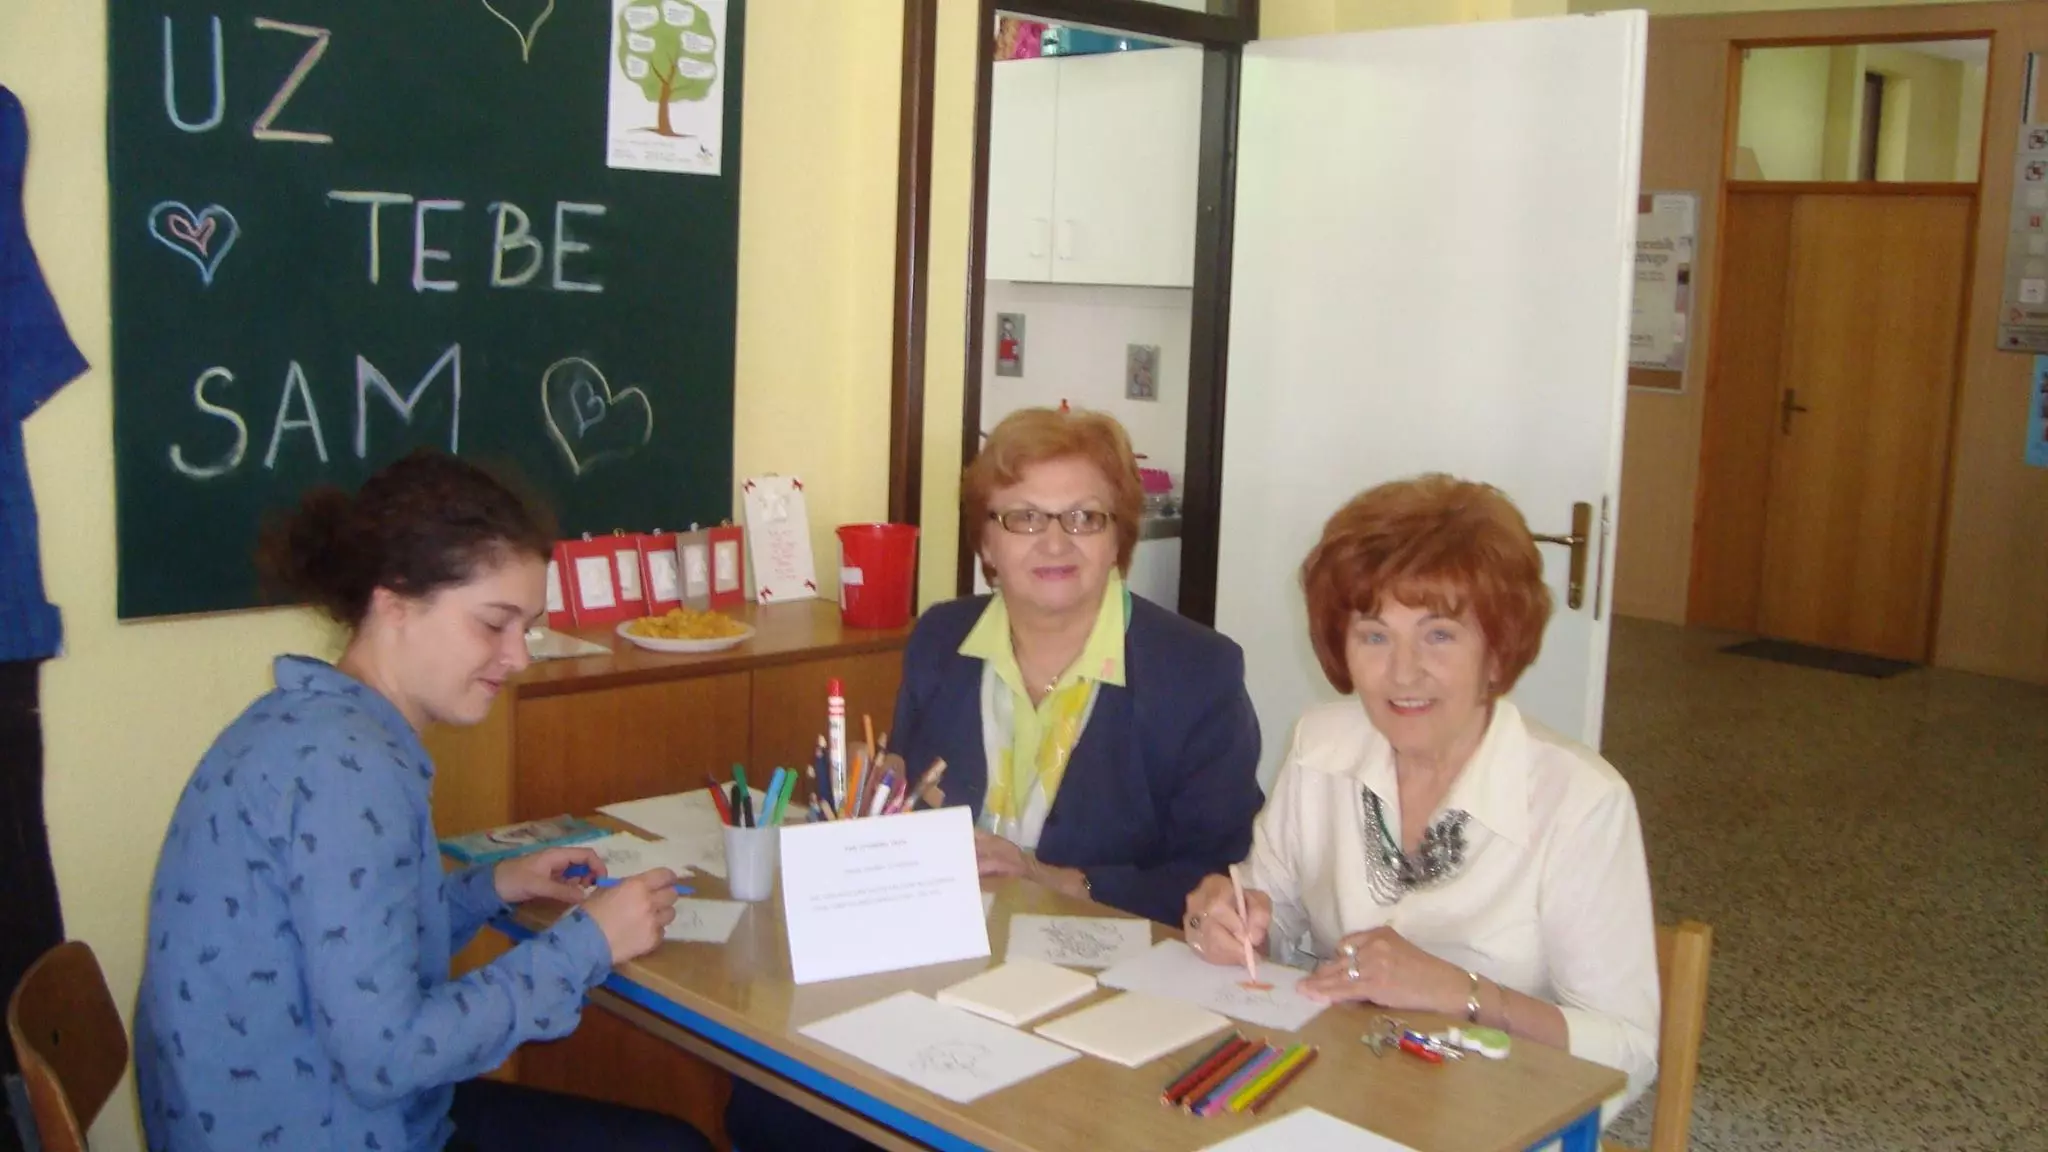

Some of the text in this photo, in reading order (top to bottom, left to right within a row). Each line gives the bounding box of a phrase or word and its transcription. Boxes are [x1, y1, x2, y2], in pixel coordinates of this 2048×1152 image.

[163, 16, 333, 144] UZ
[327, 190, 608, 291] TEBE
[169, 342, 461, 478] SAM
